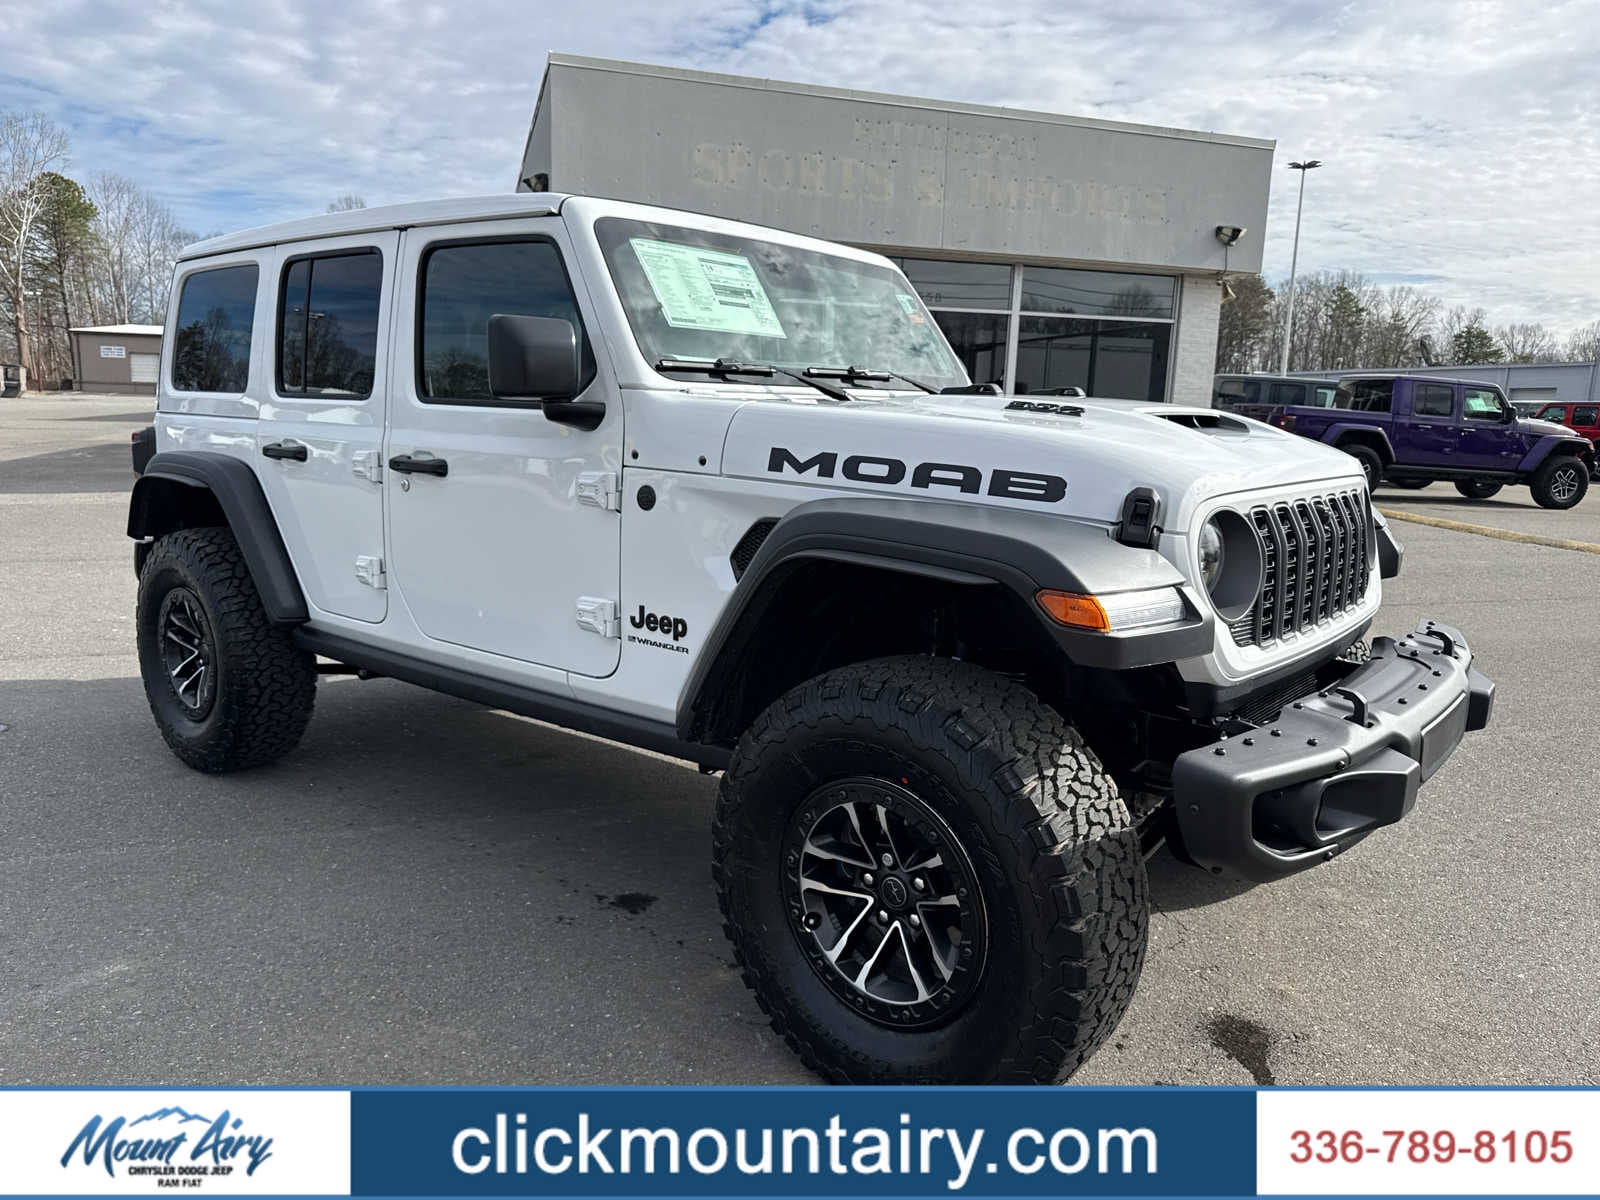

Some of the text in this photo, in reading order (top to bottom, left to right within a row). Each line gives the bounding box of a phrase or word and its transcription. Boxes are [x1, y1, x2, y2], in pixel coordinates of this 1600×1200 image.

[692, 143, 895, 201] SPORTS
[965, 169, 1172, 224] IMPORTS
[767, 447, 1068, 503] MOAB
[630, 605, 688, 642] Jeep
[637, 637, 689, 655] WRANGLER
